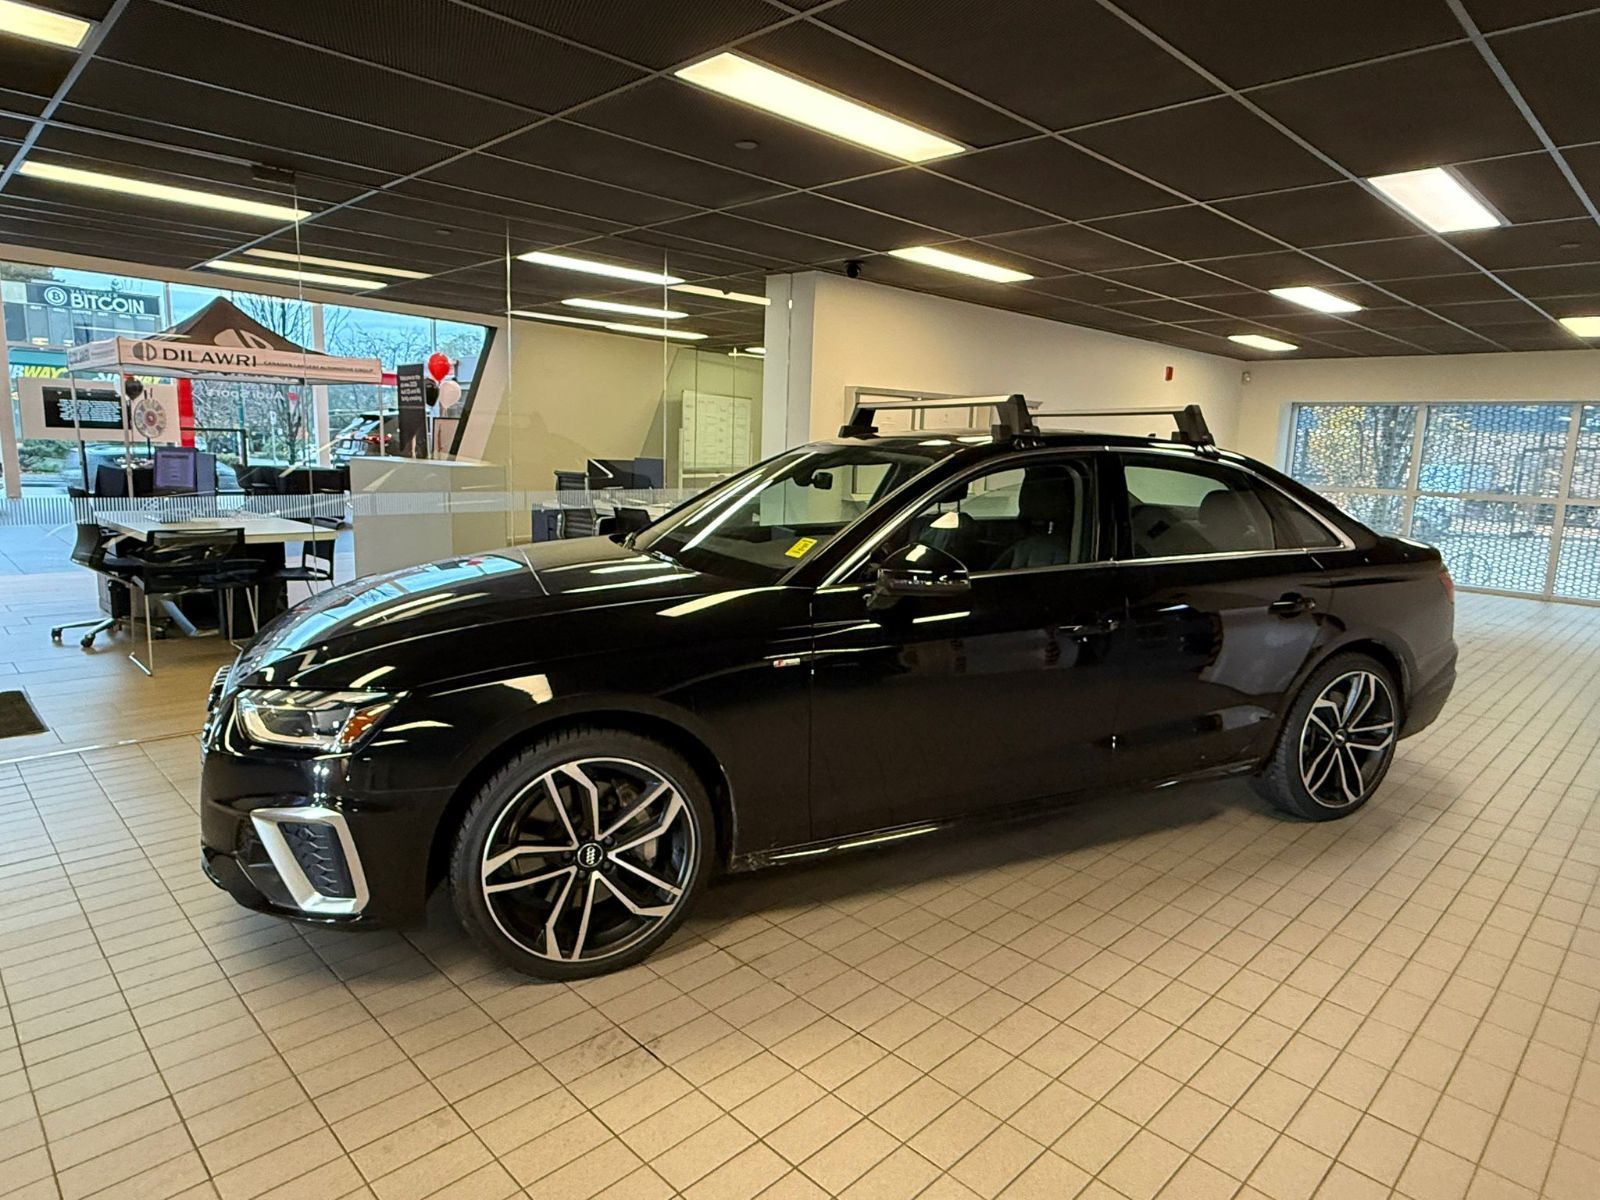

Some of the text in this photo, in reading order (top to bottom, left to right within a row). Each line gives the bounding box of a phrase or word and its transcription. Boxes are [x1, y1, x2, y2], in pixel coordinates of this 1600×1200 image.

[71, 293, 145, 314] BITCOIN
[163, 348, 257, 367] DILAWRI
[9, 365, 69, 379] BWAY
